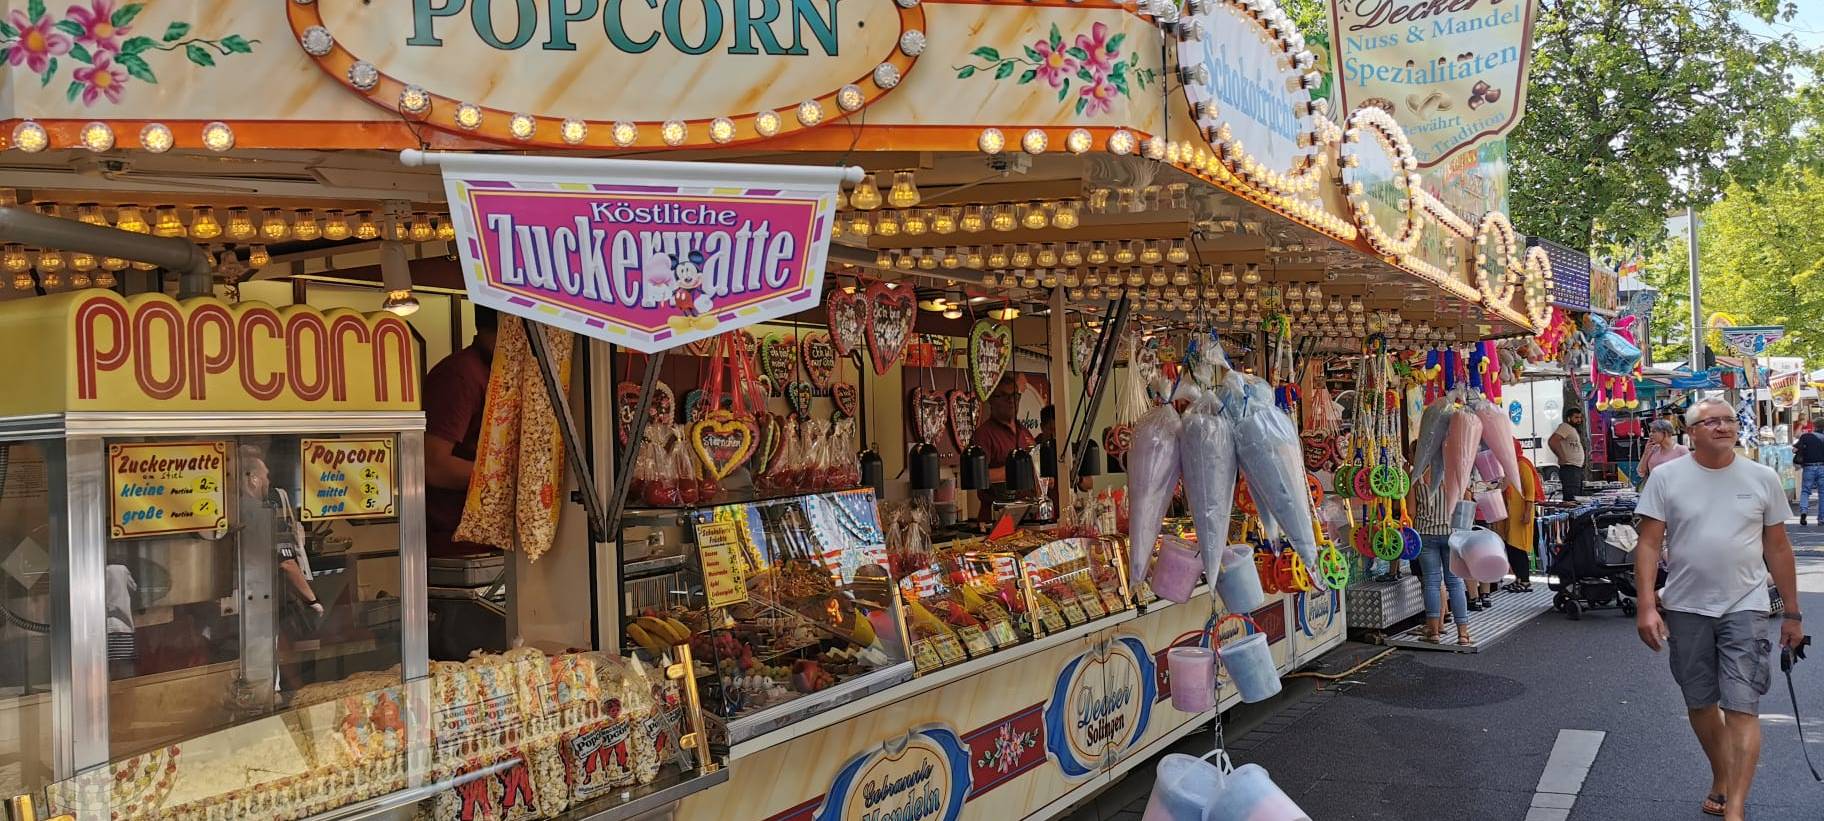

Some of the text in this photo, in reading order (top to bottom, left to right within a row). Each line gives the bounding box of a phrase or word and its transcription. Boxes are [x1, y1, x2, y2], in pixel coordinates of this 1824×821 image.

[406, 0, 841, 57] POPCORN
[1346, 4, 1521, 54] Nuss & Mandel
[1344, 45, 1518, 87] Spezialitäten
[1432, 111, 1505, 156] Tradition
[590, 201, 738, 226] Köstliche
[118, 454, 220, 474] Zuckerwatte
[311, 445, 386, 470] Popcorn
[320, 470, 345, 481] klein
[120, 482, 165, 497] kleine
[317, 486, 349, 498] mittel
[122, 506, 164, 525] große
[321, 501, 345, 516] groß
[1077, 684, 1134, 729] Decker
[1087, 713, 1125, 748] Solingen
